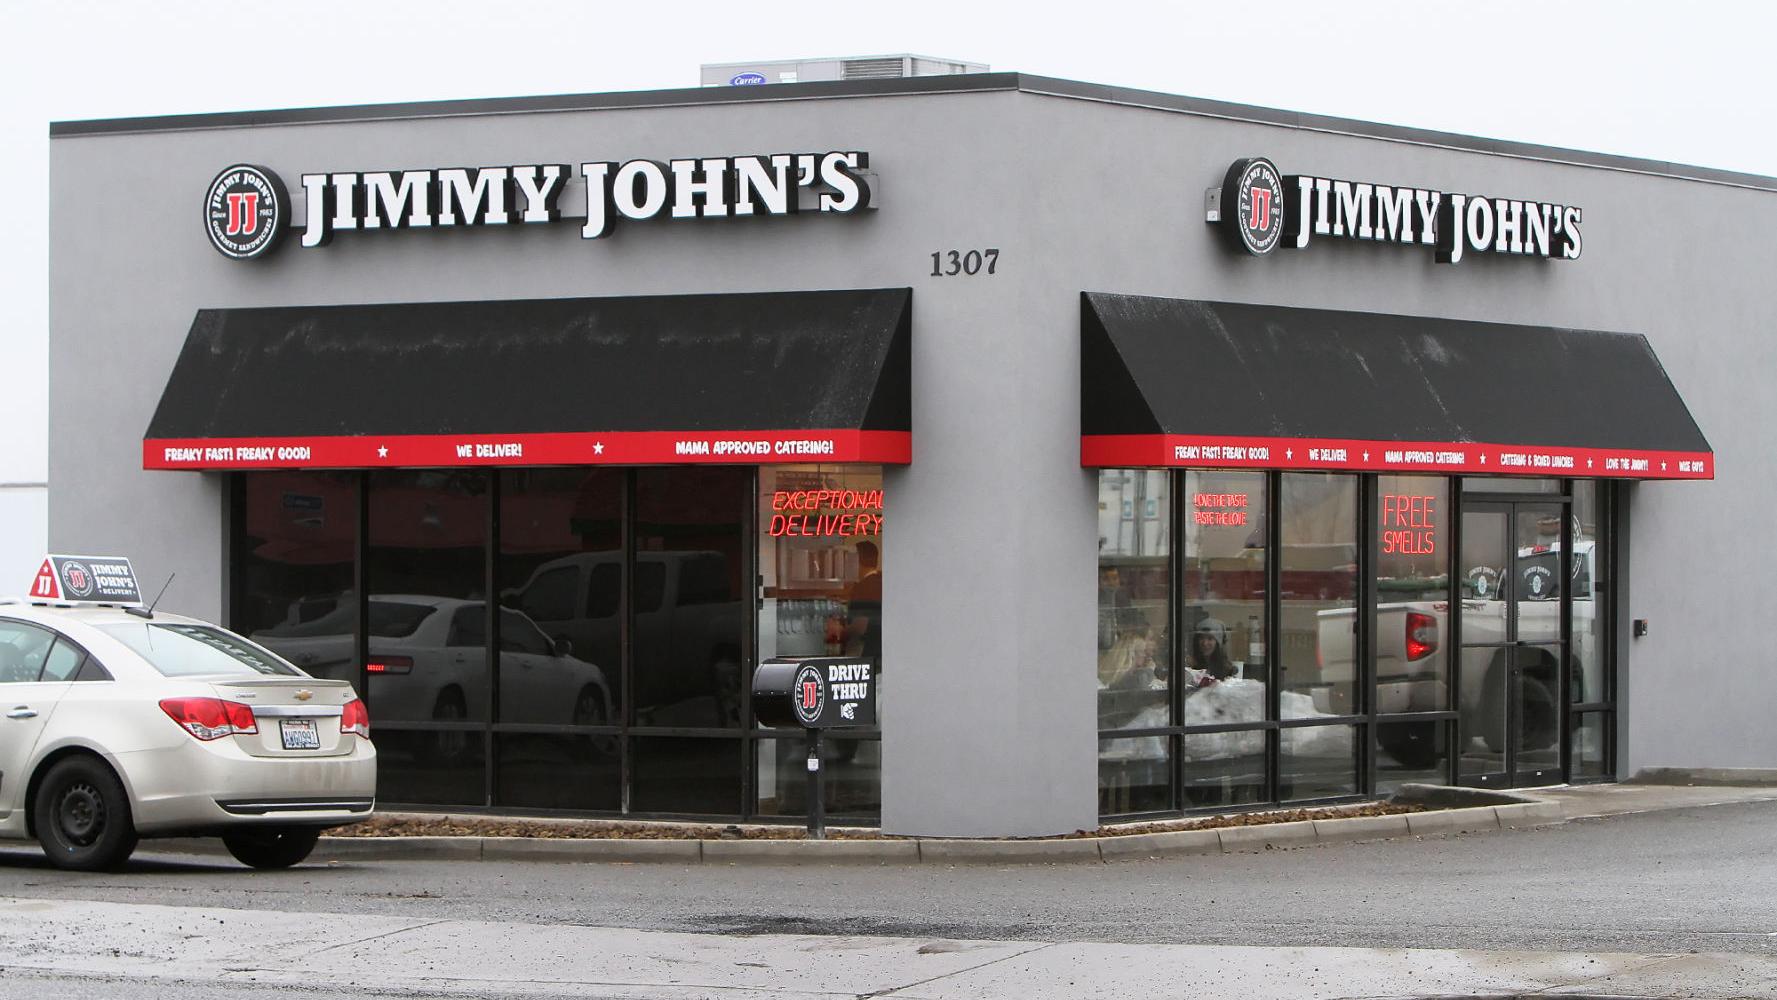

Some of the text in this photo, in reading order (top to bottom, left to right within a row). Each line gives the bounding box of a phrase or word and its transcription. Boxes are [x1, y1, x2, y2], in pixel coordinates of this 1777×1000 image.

[734, 76, 762, 86] Carrier
[211, 172, 273, 210] JIMMY JOHN'S
[1241, 167, 1261, 201] JIMMY
[302, 151, 859, 247] JIMMY JOHN'S
[226, 192, 260, 236] JJ
[1249, 186, 1272, 232] JJ
[1297, 175, 1582, 264] JIMMY JOHN'S
[212, 220, 238, 251] GOURMET
[930, 248, 1000, 277] 1307
[165, 446, 311, 461] FREAKY FAST! FREAKY GOOD!
[457, 443, 522, 457] WE DELIVER!
[676, 440, 834, 455] MAMA APPROVED CATERING!
[1175, 446, 1269, 460] FREAKY FAST! FREAKY GOOD!
[1309, 448, 1347, 461] WE DELIVER!
[1385, 450, 1465, 464] MAMA APPROVED CATERING!
[1501, 453, 1527, 466] CATERING
[1528, 454, 1533, 466] &
[1606, 458, 1619, 470] LOVE
[772, 489, 884, 510] EXCEPTIONAL
[1194, 493, 1248, 507] LOVE THE TASTE
[1193, 511, 1248, 525] TASTE THE LOVE
[1383, 495, 1435, 528] FREE
[769, 513, 885, 536] DELIVERY
[1383, 530, 1435, 554] SMELLS
[90, 564, 129, 576] JIMMY
[37, 575, 53, 595] JJ
[94, 576, 134, 589] JOHN'S
[828, 664, 870, 682] DRIVE
[802, 681, 818, 709] JJ
[831, 682, 868, 700] THRU
